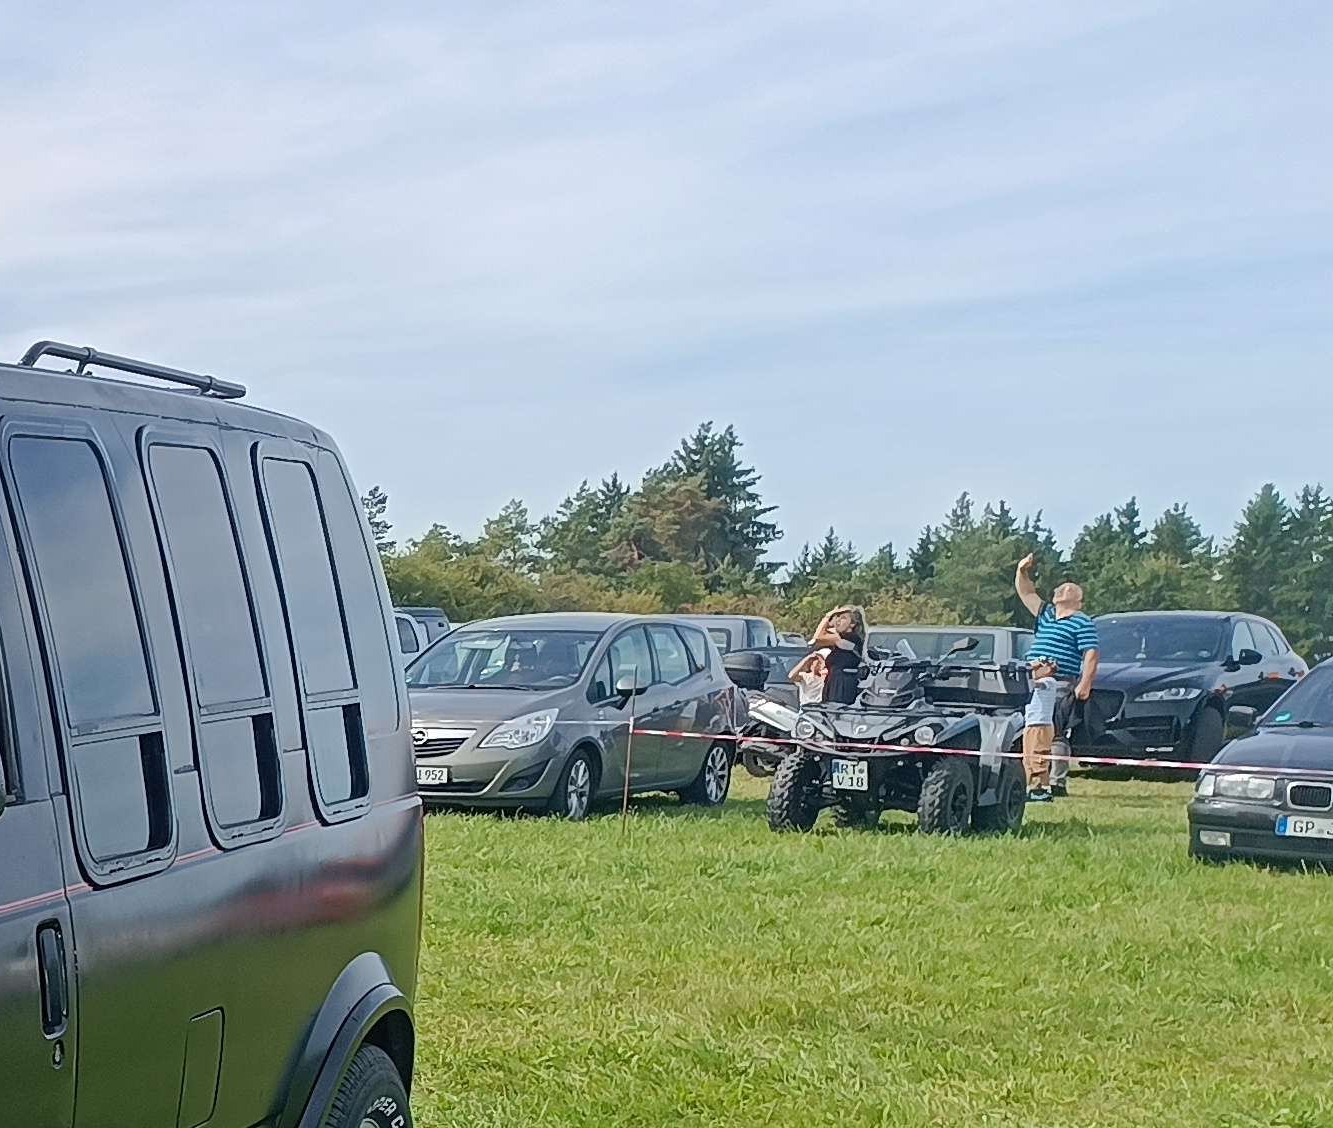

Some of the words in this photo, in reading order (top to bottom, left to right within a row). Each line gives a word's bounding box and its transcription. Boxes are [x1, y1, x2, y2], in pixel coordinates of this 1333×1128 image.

[424, 769, 444, 781] 952
[840, 763, 856, 775] RT
[837, 775, 844, 785] V
[847, 776, 864, 787] 18
[1293, 820, 1315, 834] GP
